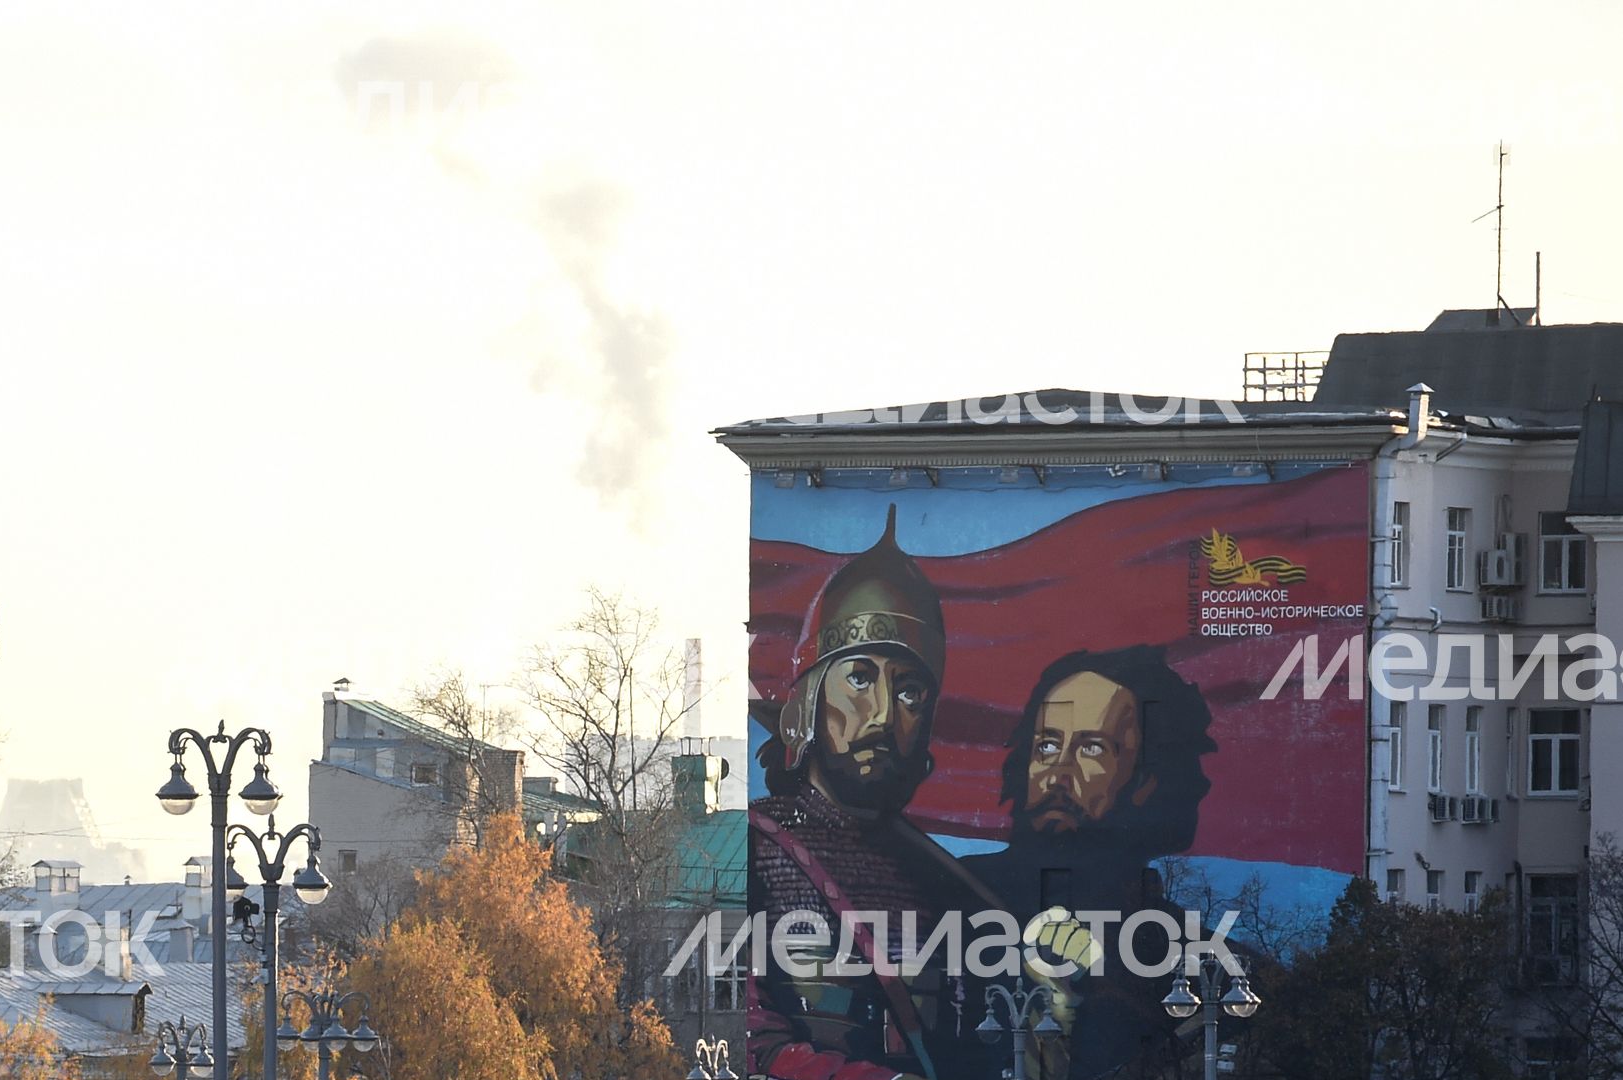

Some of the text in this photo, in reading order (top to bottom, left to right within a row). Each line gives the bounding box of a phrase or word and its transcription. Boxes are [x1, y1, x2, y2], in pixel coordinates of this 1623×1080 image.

[1202, 588, 1289, 603] РОССИЙСКОЕ
[1202, 605, 1364, 620] ВОЕННО-ИСТОРИЧЕСКОЕ
[1201, 623, 1273, 638] ОБЩЕСТВО
